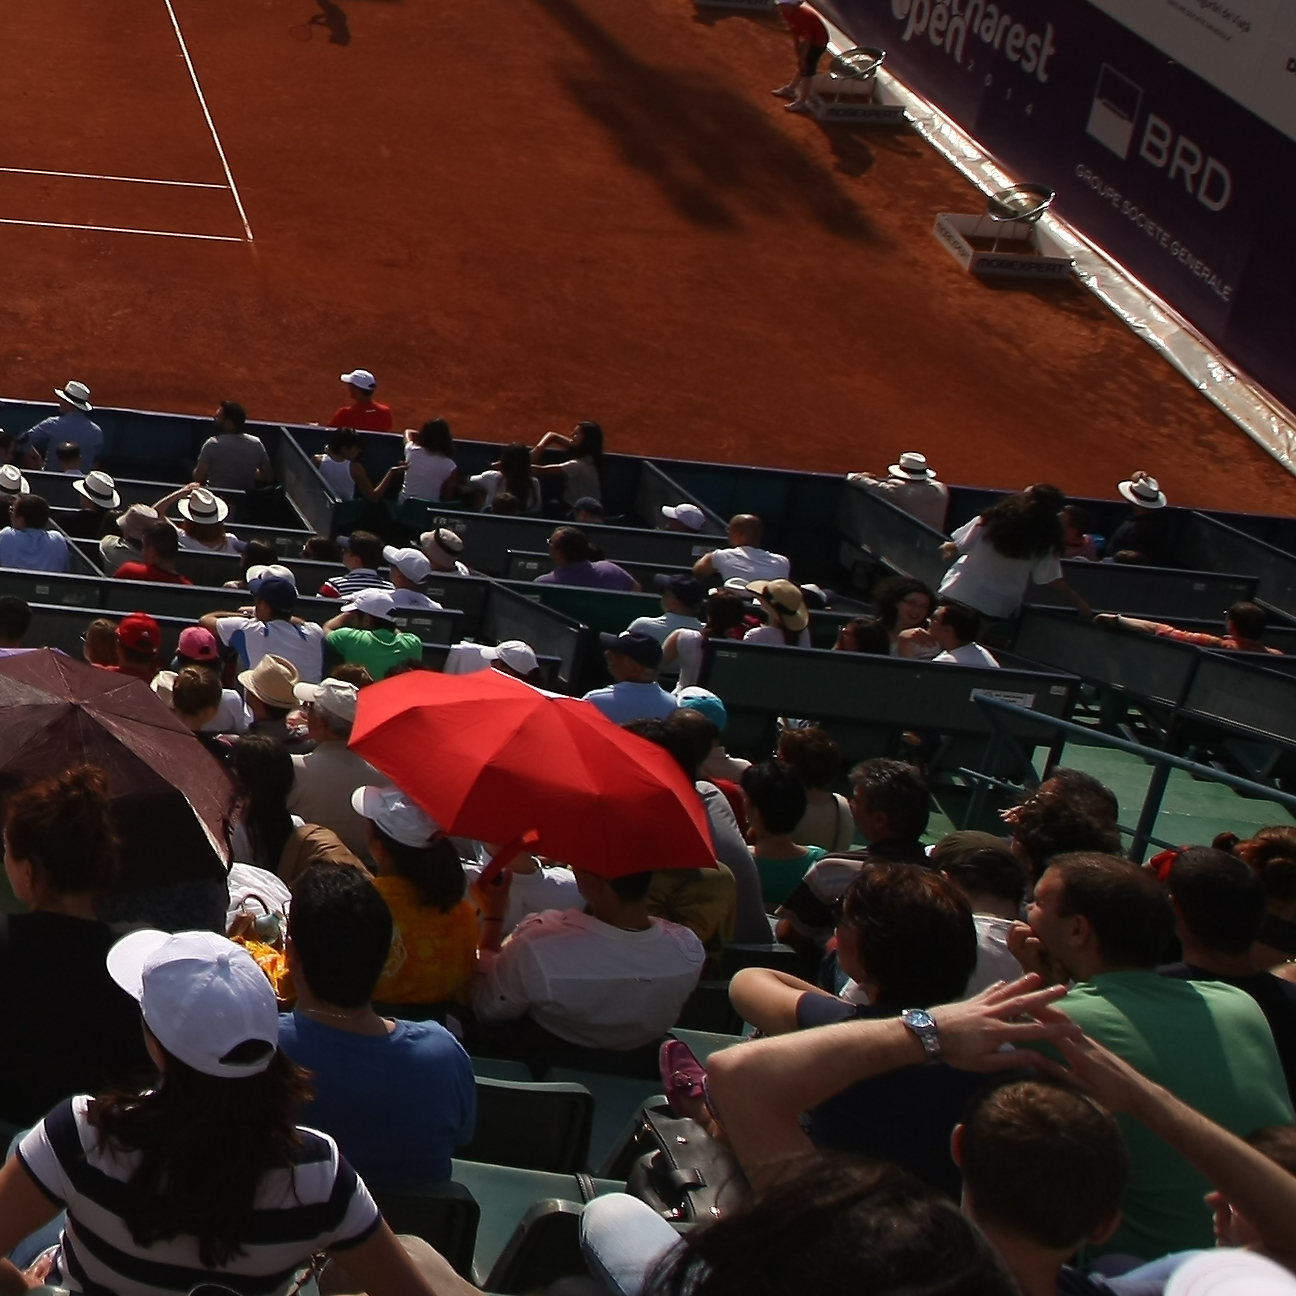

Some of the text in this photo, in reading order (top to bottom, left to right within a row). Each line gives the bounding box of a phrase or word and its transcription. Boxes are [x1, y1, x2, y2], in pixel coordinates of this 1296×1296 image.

[1138, 112, 1233, 213] BRD
[977, 258, 1067, 275] MOBEXPERT
[1075, 163, 1234, 303] GROUPE SOCIETE GENERALE
